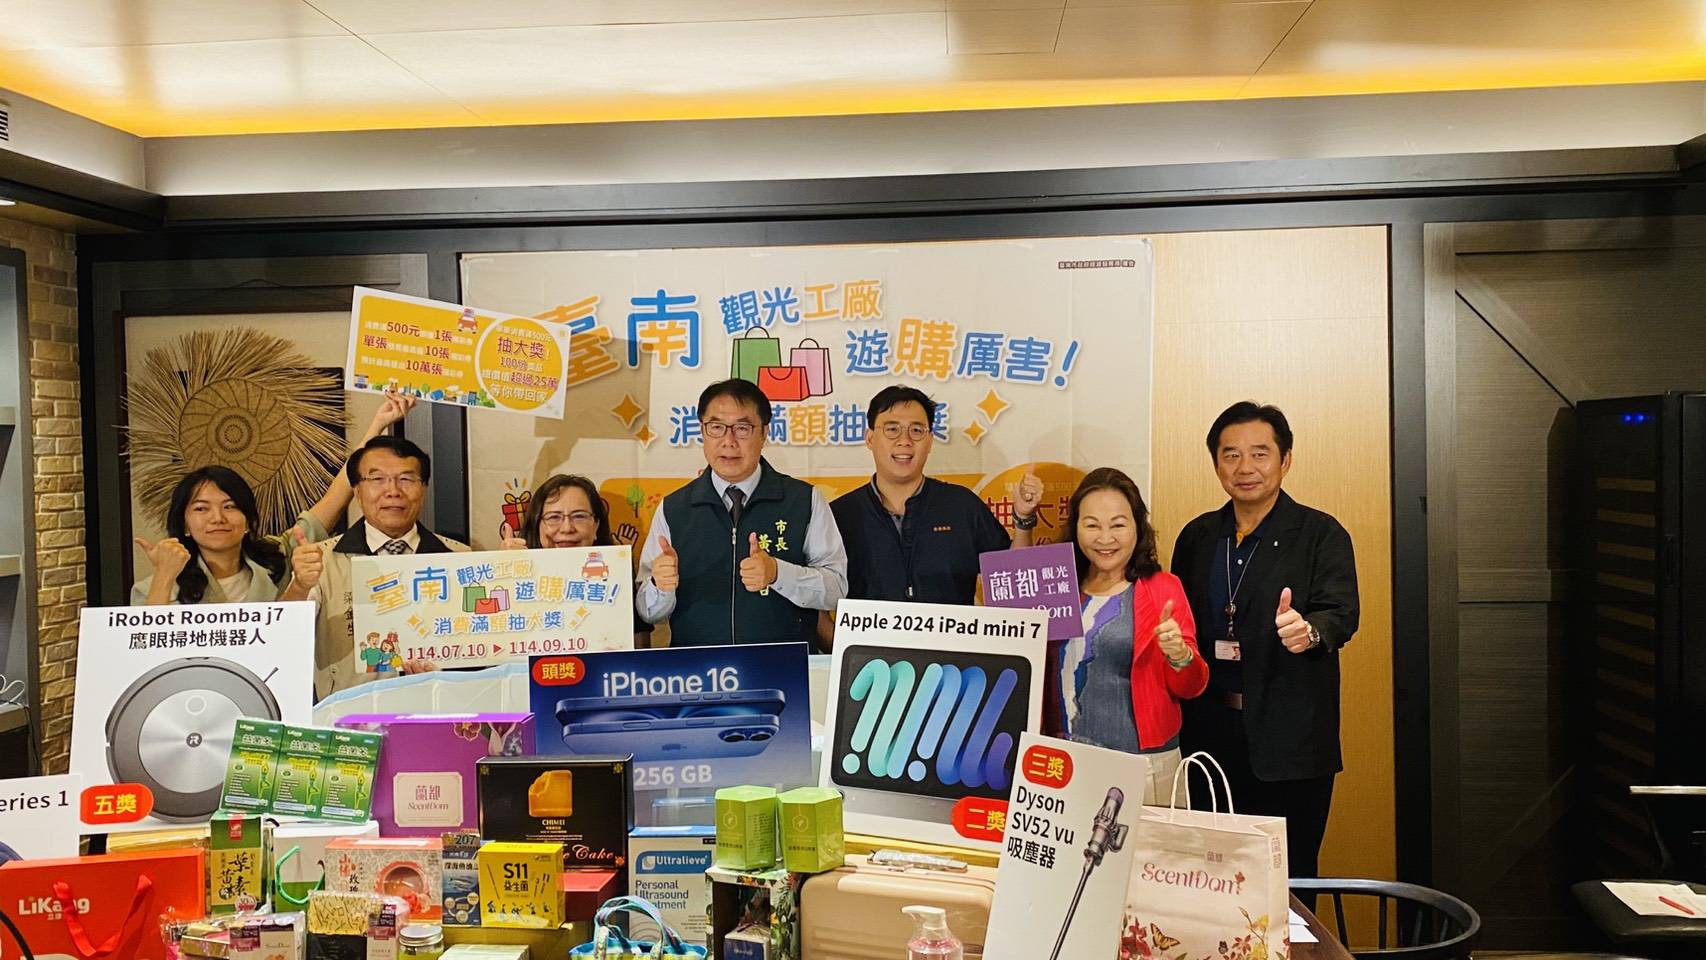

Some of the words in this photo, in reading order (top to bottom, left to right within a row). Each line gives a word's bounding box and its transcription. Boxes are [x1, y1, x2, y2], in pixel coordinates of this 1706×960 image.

[719, 280, 882, 334] 觀光工廠
[846, 319, 1079, 388] 遊購厲害!
[775, 519, 789, 552] 市長
[457, 560, 534, 585] 觀光工廠
[1042, 565, 1069, 580] 觀光
[367, 566, 450, 614] 臺南
[515, 576, 620, 604] 遊購厲害!
[989, 569, 1039, 601] 蘭都
[1043, 581, 1070, 595] 工廠
[108, 611, 175, 628] iRobot
[181, 608, 261, 625] Roomba
[265, 607, 285, 626] j7
[434, 611, 562, 635] 消費滿額抽大獎
[840, 612, 888, 631] Apple
[892, 615, 935, 632] 2024
[939, 616, 978, 635] iPad
[983, 620, 1025, 638] mini
[1030, 622, 1042, 639] 7
[129, 629, 267, 650] 鷹眼掃地機器人
[407, 643, 486, 660] 114.07.10
[509, 638, 587, 655] 114.09.10
[542, 662, 577, 680] 頭獎
[603, 671, 703, 697] iPhone
[706, 666, 740, 693] 16
[634, 766, 675, 786] 256
[681, 764, 713, 784] GB
[1029, 753, 1065, 780] 三獎
[0, 792, 50, 812] eries
[93, 793, 137, 815] 五獎
[1016, 785, 1065, 814] Dyson
[967, 808, 1005, 832] 二獎
[1012, 812, 1051, 838] SV52
[1055, 826, 1075, 845] vu
[455, 835, 477, 845] 207
[572, 844, 614, 860] Cake
[656, 855, 706, 865] Ultralieve
[1008, 836, 1056, 869] 吸塵器
[503, 862, 528, 879] S11
[504, 880, 529, 892] 益生菌
[635, 880, 679, 890] Personal
[635, 890, 689, 900] Ultrasound
[18, 897, 91, 915] LiKag
